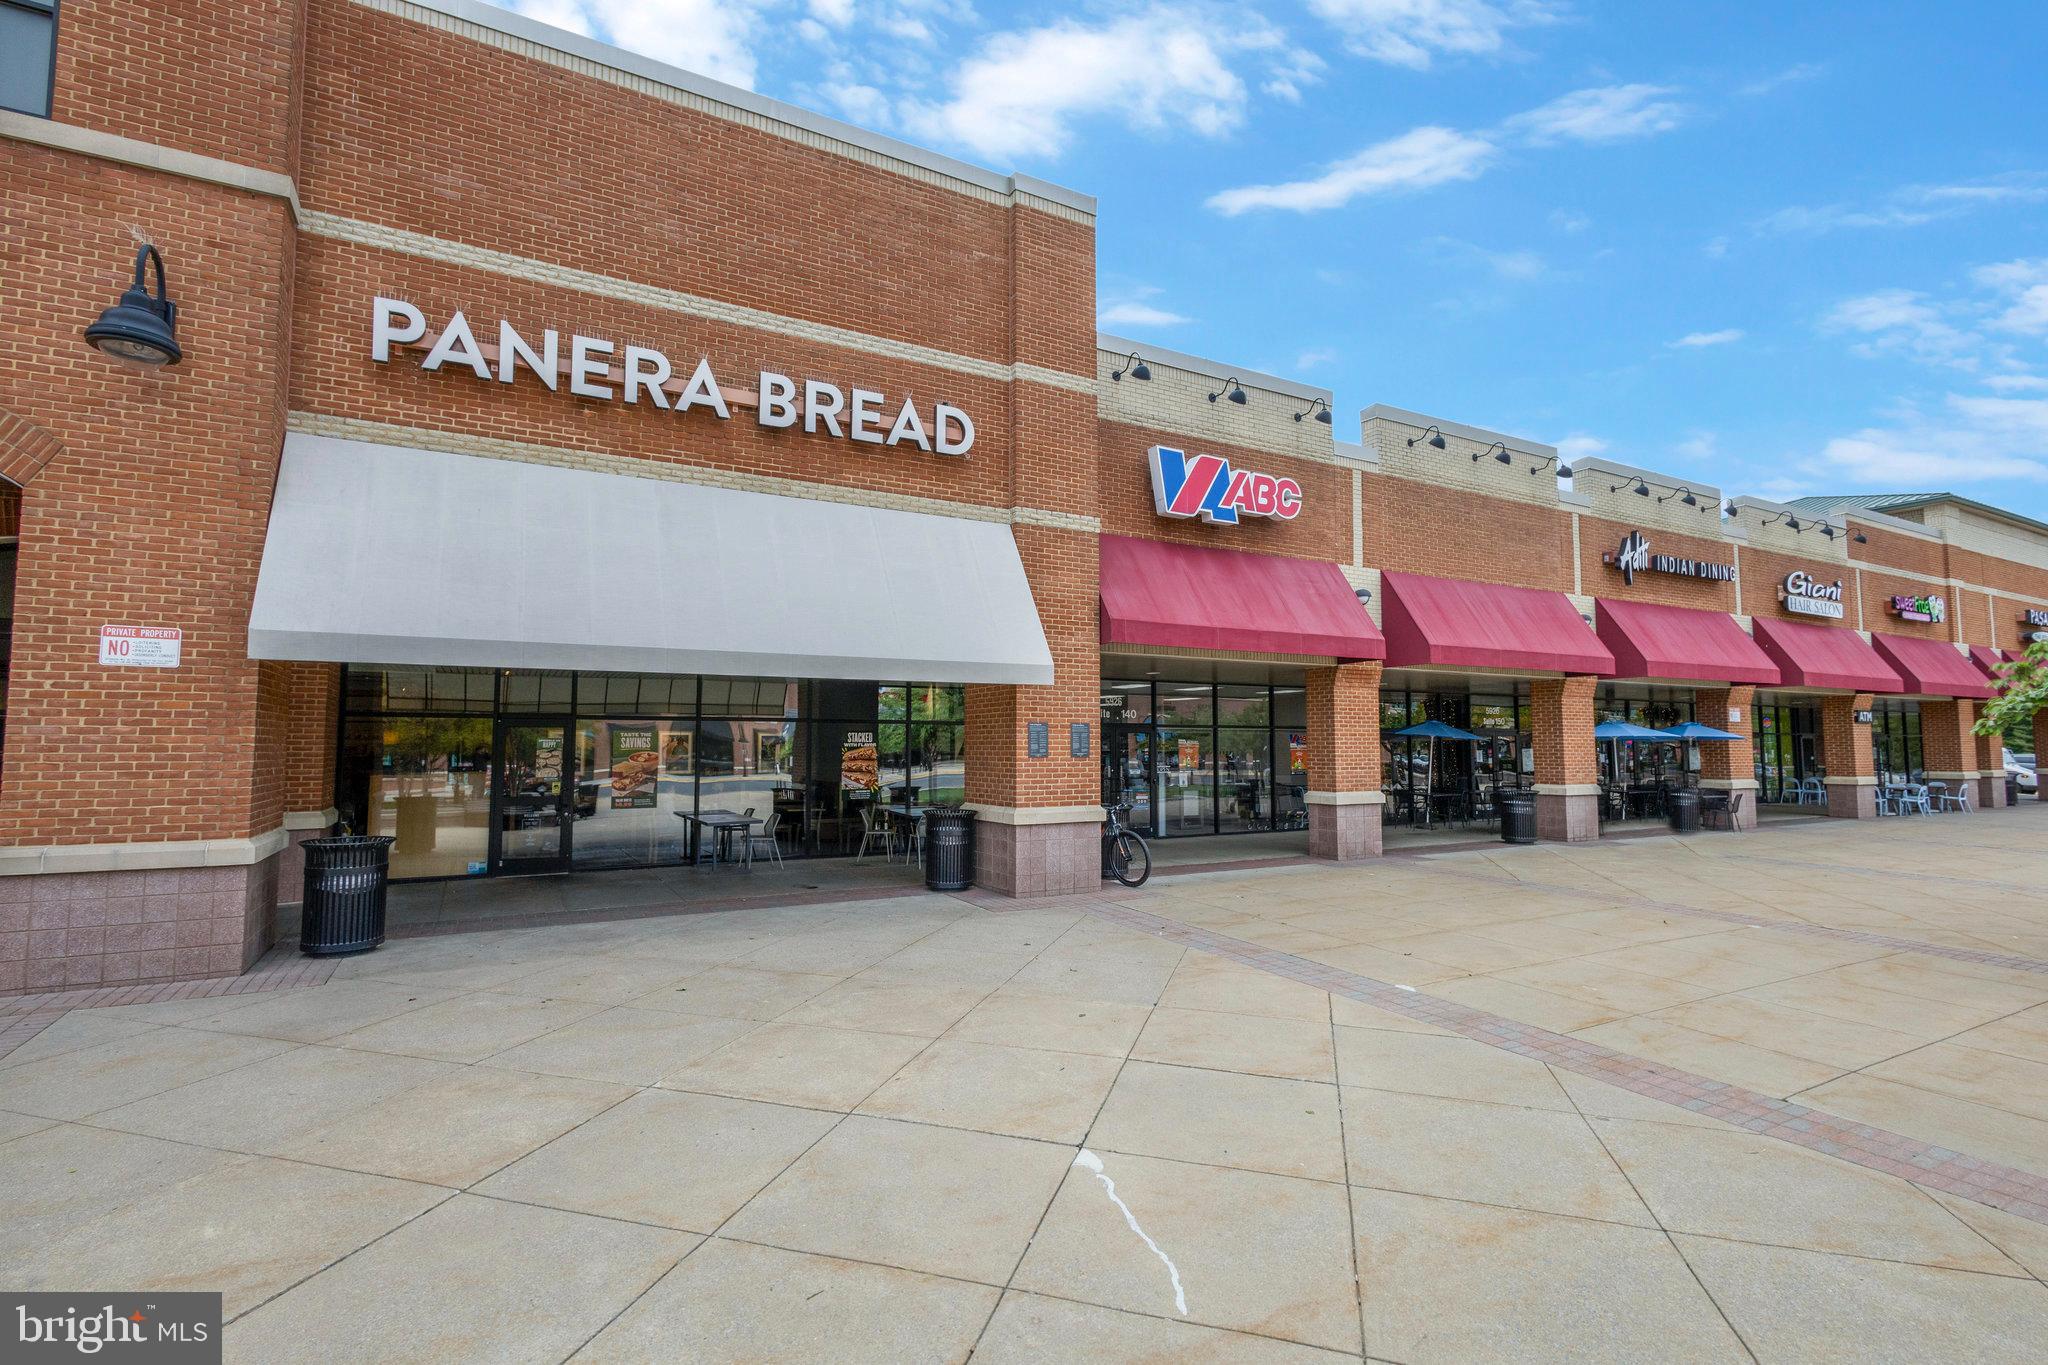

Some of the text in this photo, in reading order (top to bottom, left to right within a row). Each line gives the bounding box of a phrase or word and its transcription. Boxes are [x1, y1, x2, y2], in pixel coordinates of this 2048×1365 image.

[372, 296, 975, 455] PANERA BREAD
[1656, 554, 1695, 576] INDIAN
[1700, 561, 1736, 581] DINING
[1787, 570, 1842, 601] Giani
[1790, 596, 1841, 616] HAIR SALON
[106, 627, 177, 639] PRIVATE PROPERTY
[108, 639, 130, 656] NO
[1121, 709, 1137, 719] 140
[1859, 711, 1873, 722] ATM
[620, 737, 651, 749] SAVINGS
[847, 732, 873, 743] STACKED
